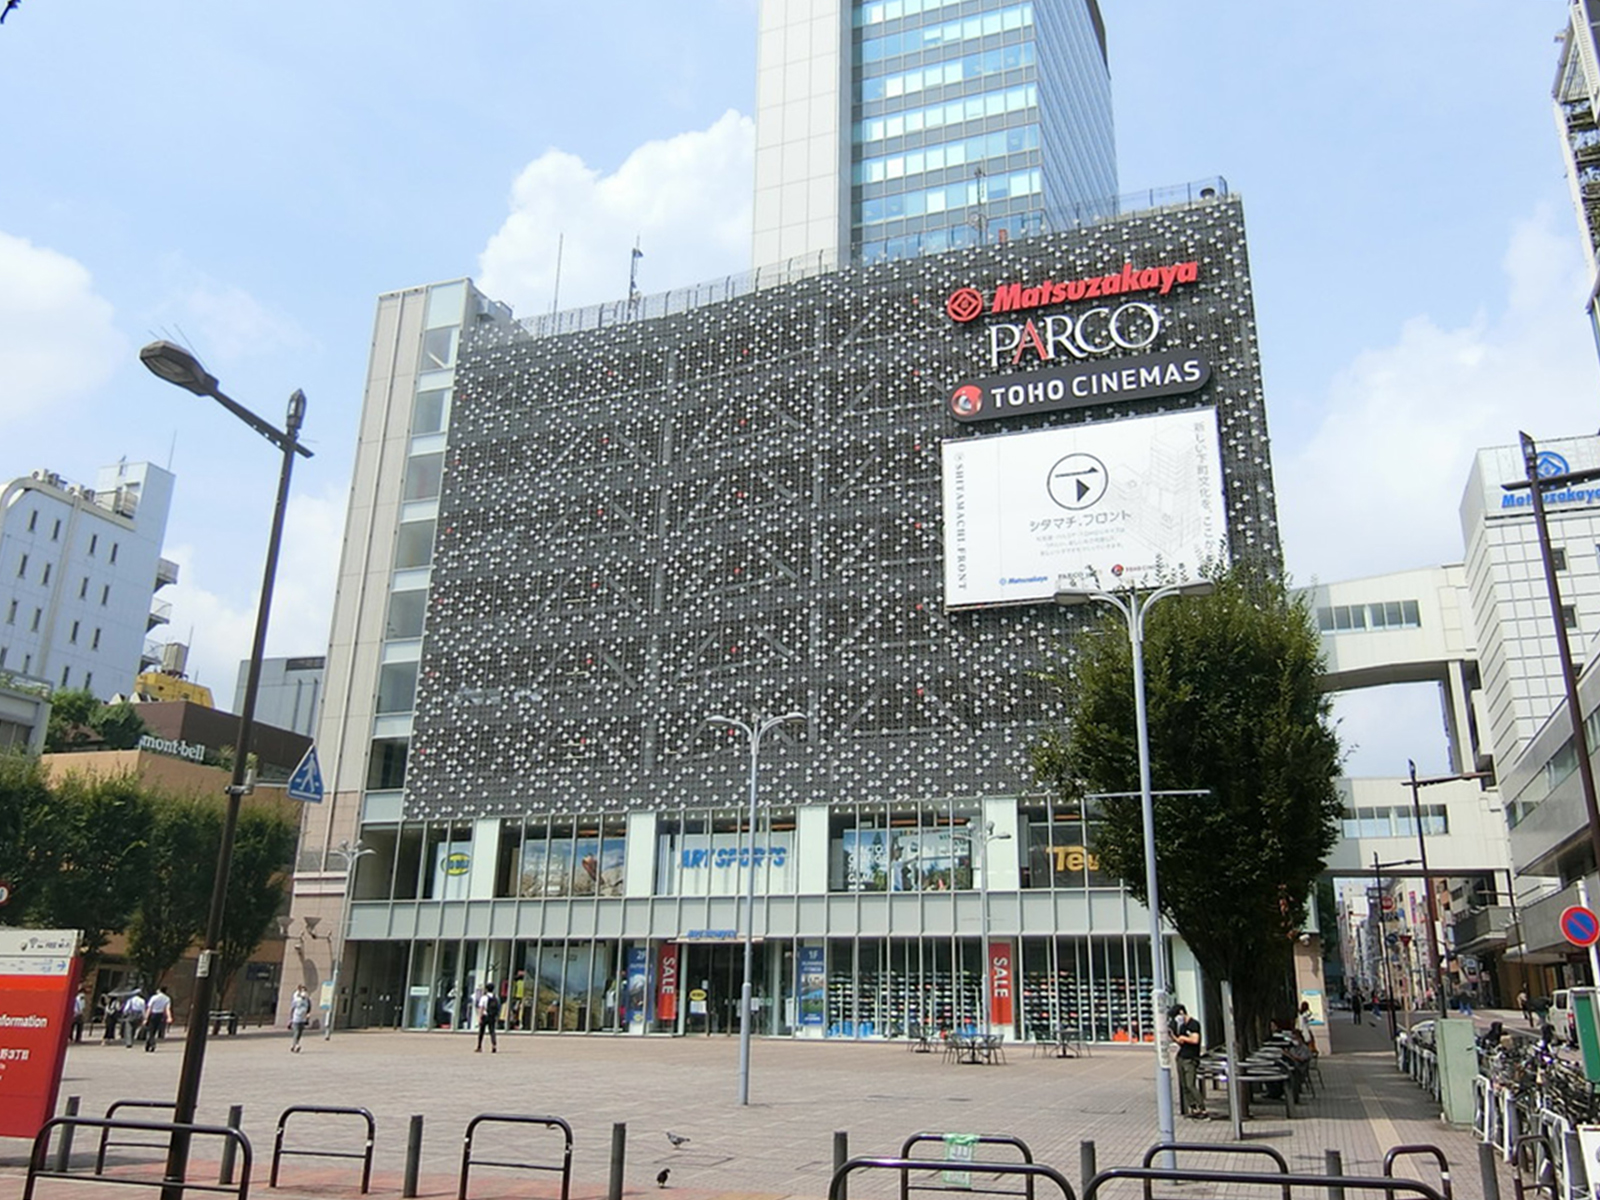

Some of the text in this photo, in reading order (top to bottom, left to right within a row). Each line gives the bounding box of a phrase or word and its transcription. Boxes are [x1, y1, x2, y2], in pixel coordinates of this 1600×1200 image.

[991, 261, 1199, 314] Matsuzakaya
[988, 302, 1161, 368] PARCO
[990, 359, 1201, 408] TOHO CINEMAS
[662, 957, 676, 994] SALE
[993, 957, 1009, 997] SALE
